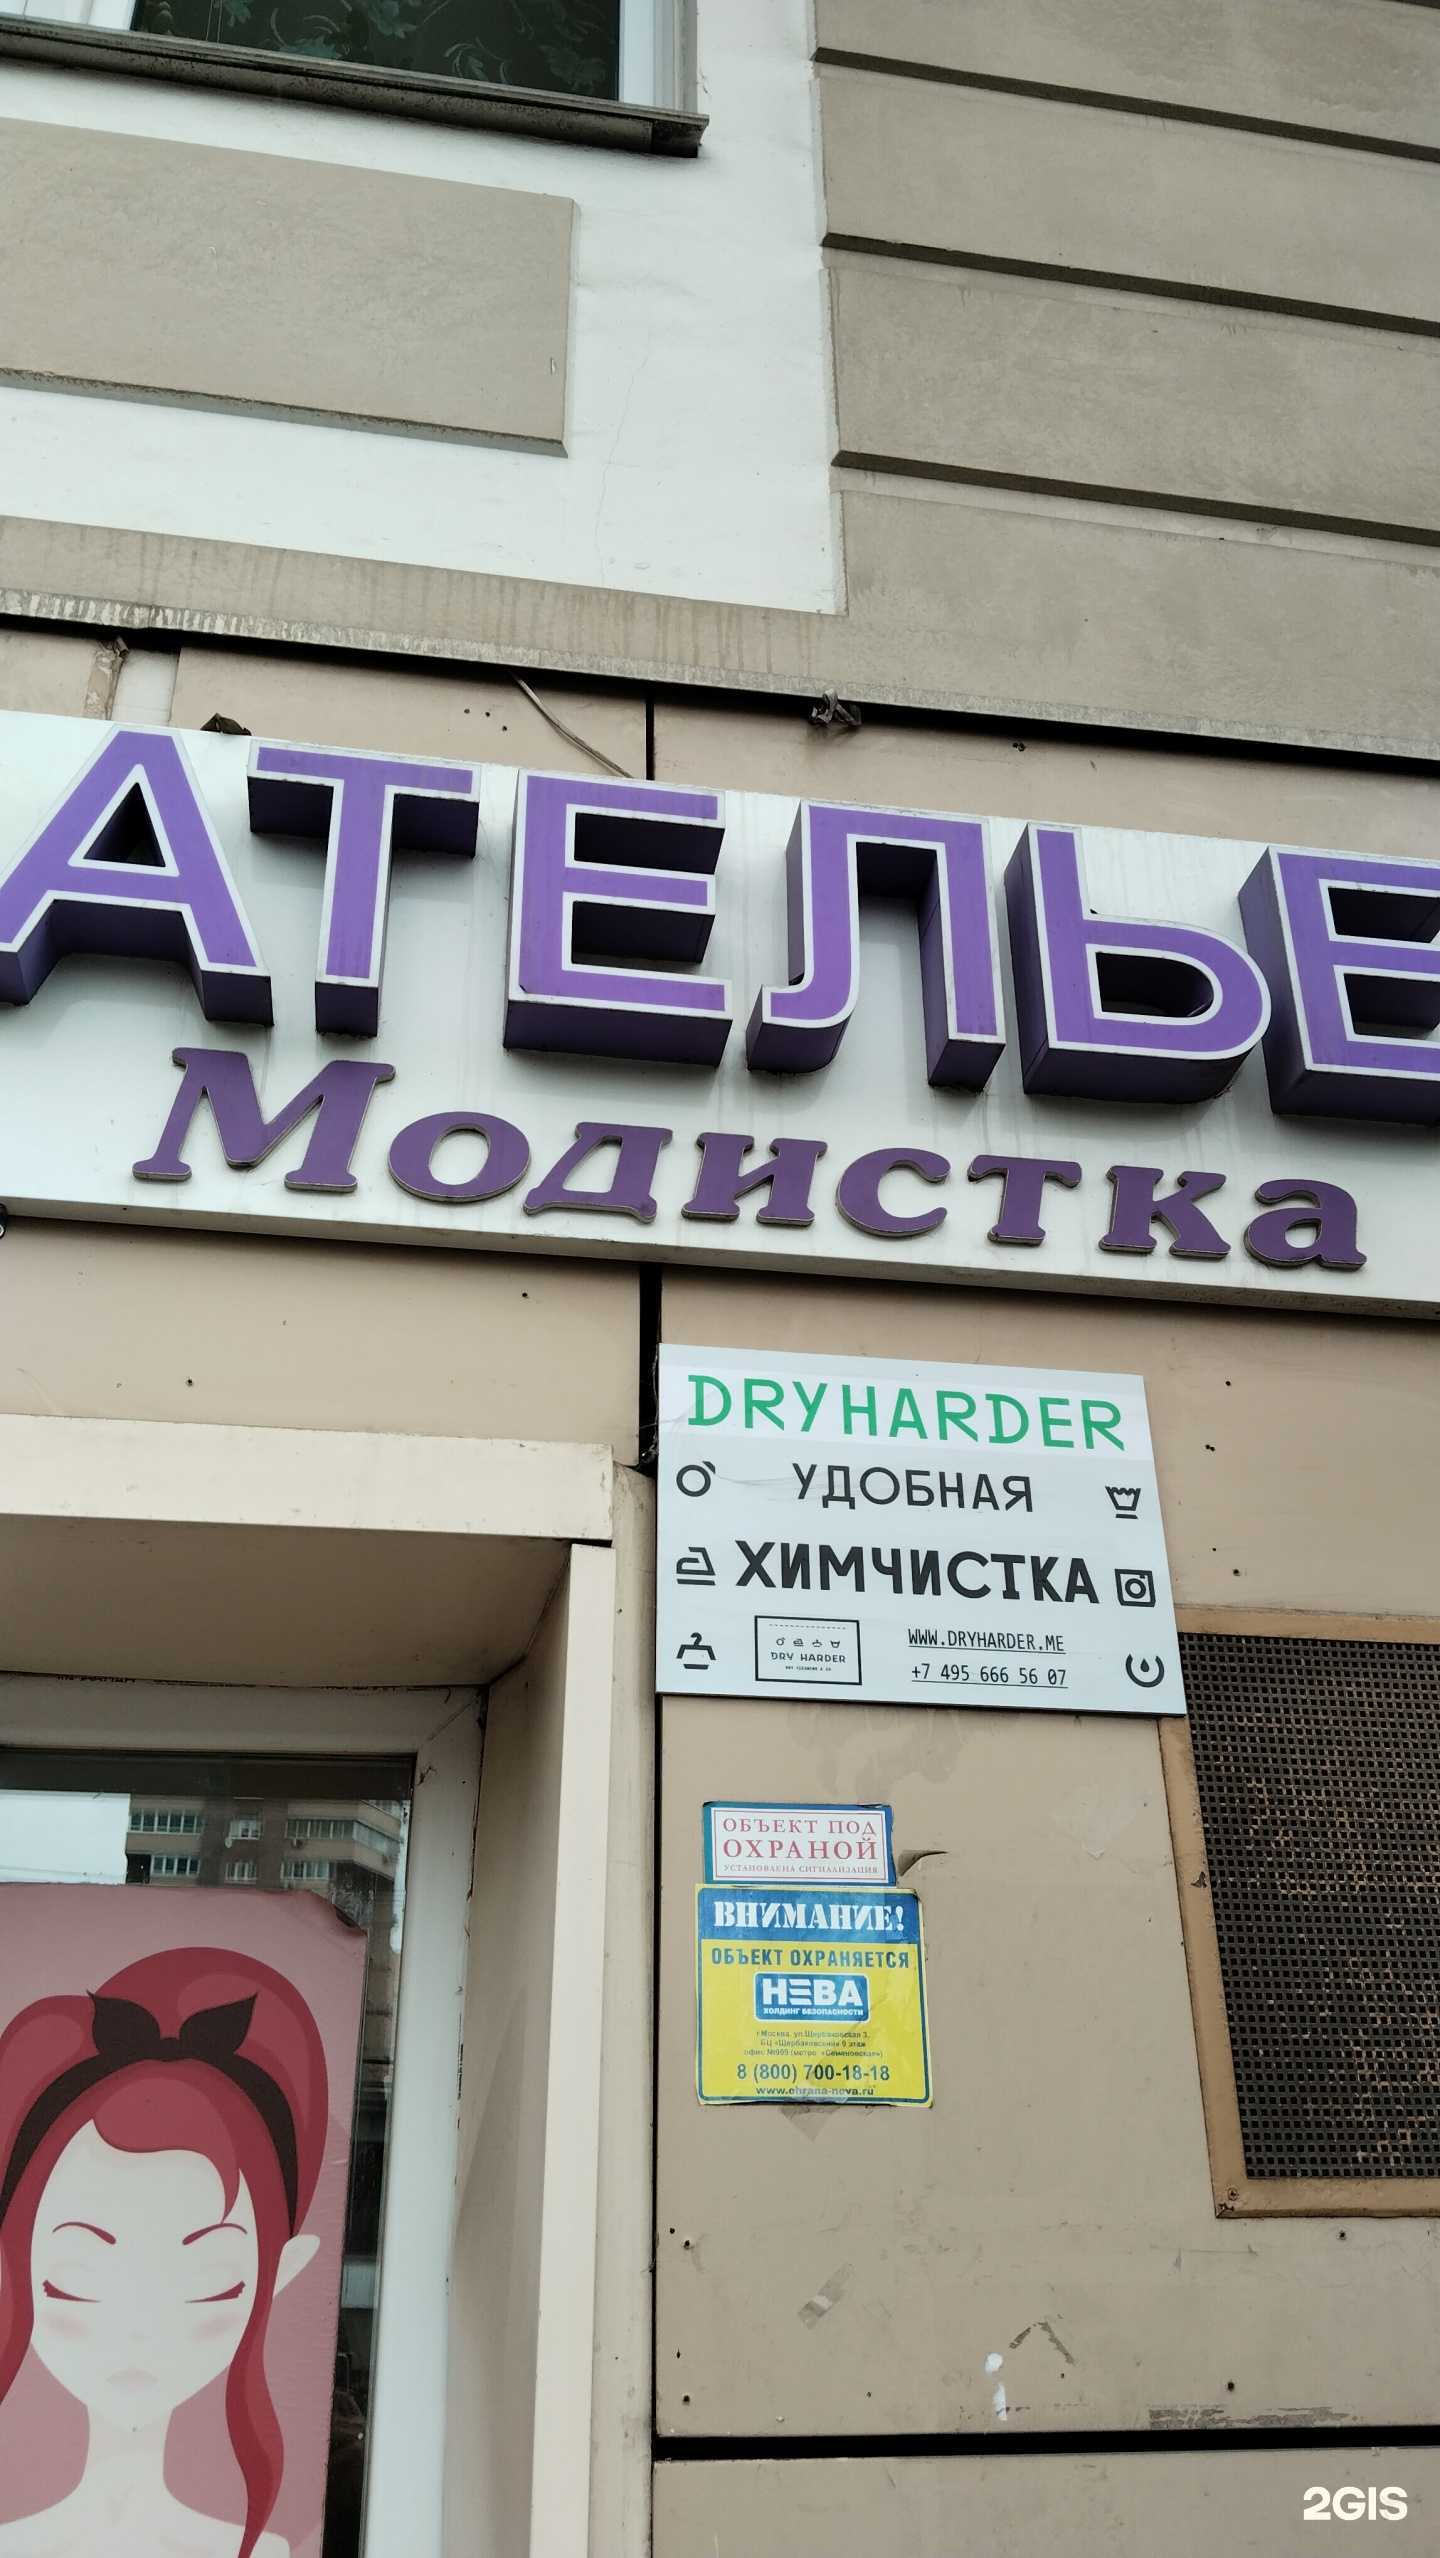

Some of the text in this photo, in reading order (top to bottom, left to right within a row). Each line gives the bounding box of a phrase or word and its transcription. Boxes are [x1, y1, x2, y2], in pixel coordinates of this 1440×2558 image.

[0, 724, 1440, 1105] АТЕЛЬЕ
[132, 1047, 1367, 1270] Модистка
[688, 1374, 1125, 1451] DRYHARDER
[792, 1462, 1034, 1512] УДОБНАЯ
[735, 1539, 1100, 1604] ХИМЧИСТКА
[908, 1628, 1064, 1651] WWW.DRYHARDER.ME
[770, 1651, 846, 1663] DRY HARDER
[912, 1663, 1066, 1685] +7 495 666 56 07
[723, 1818, 877, 1836] ОБЪЕКТ ПОД
[723, 1837, 877, 1860] ОХРАНОЙ
[713, 1901, 904, 1931] ВНИМАНИЕ!
[711, 1948, 909, 1968] ОБЪЕКТ ОХРАНЯЕТСЯ
[762, 1978, 863, 2006] НЕВА
[737, 2063, 890, 2083] 8 (800) 700-18-18
